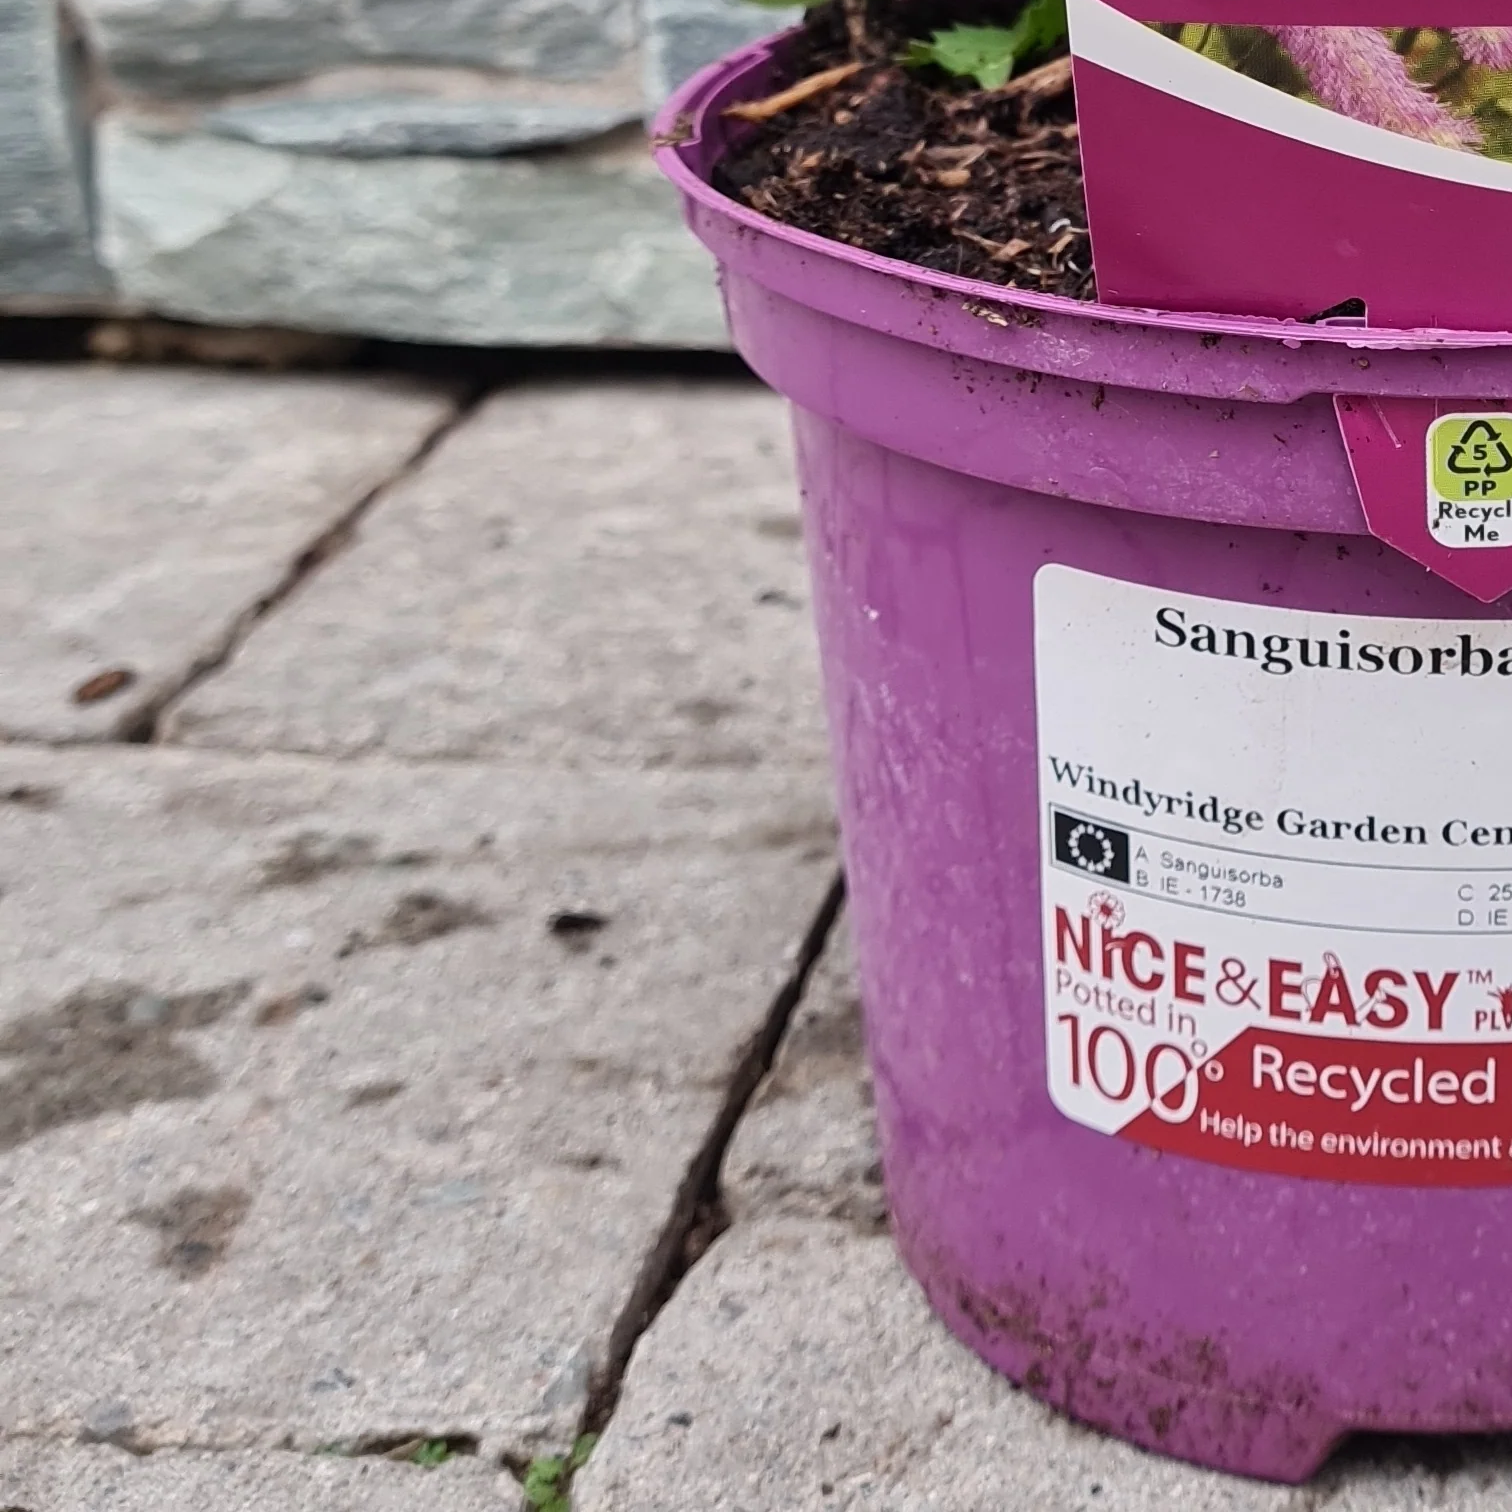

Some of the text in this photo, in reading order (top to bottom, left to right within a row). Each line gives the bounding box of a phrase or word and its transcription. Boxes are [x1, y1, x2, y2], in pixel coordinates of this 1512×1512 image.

[1472, 443, 1488, 461] 5
[1464, 480, 1497, 497] PP
[1464, 524, 1500, 542] Me
[1046, 755, 1265, 836] Windyridge
[1276, 808, 1428, 847] Garden
[1134, 845, 1285, 889] A Sanguisorba
[1136, 869, 1149, 888] B
[1159, 875, 1178, 894] IE
[1200, 885, 1247, 908] 1738
[1458, 883, 1474, 902] C
[1458, 908, 1508, 927] D IE
[1055, 966, 1198, 1039] Potted in
[1251, 1043, 1497, 1112] Recycled
[1200, 1107, 1262, 1148] Help
[1269, 1122, 1315, 1153] the
[1320, 1130, 1502, 1161] environment
